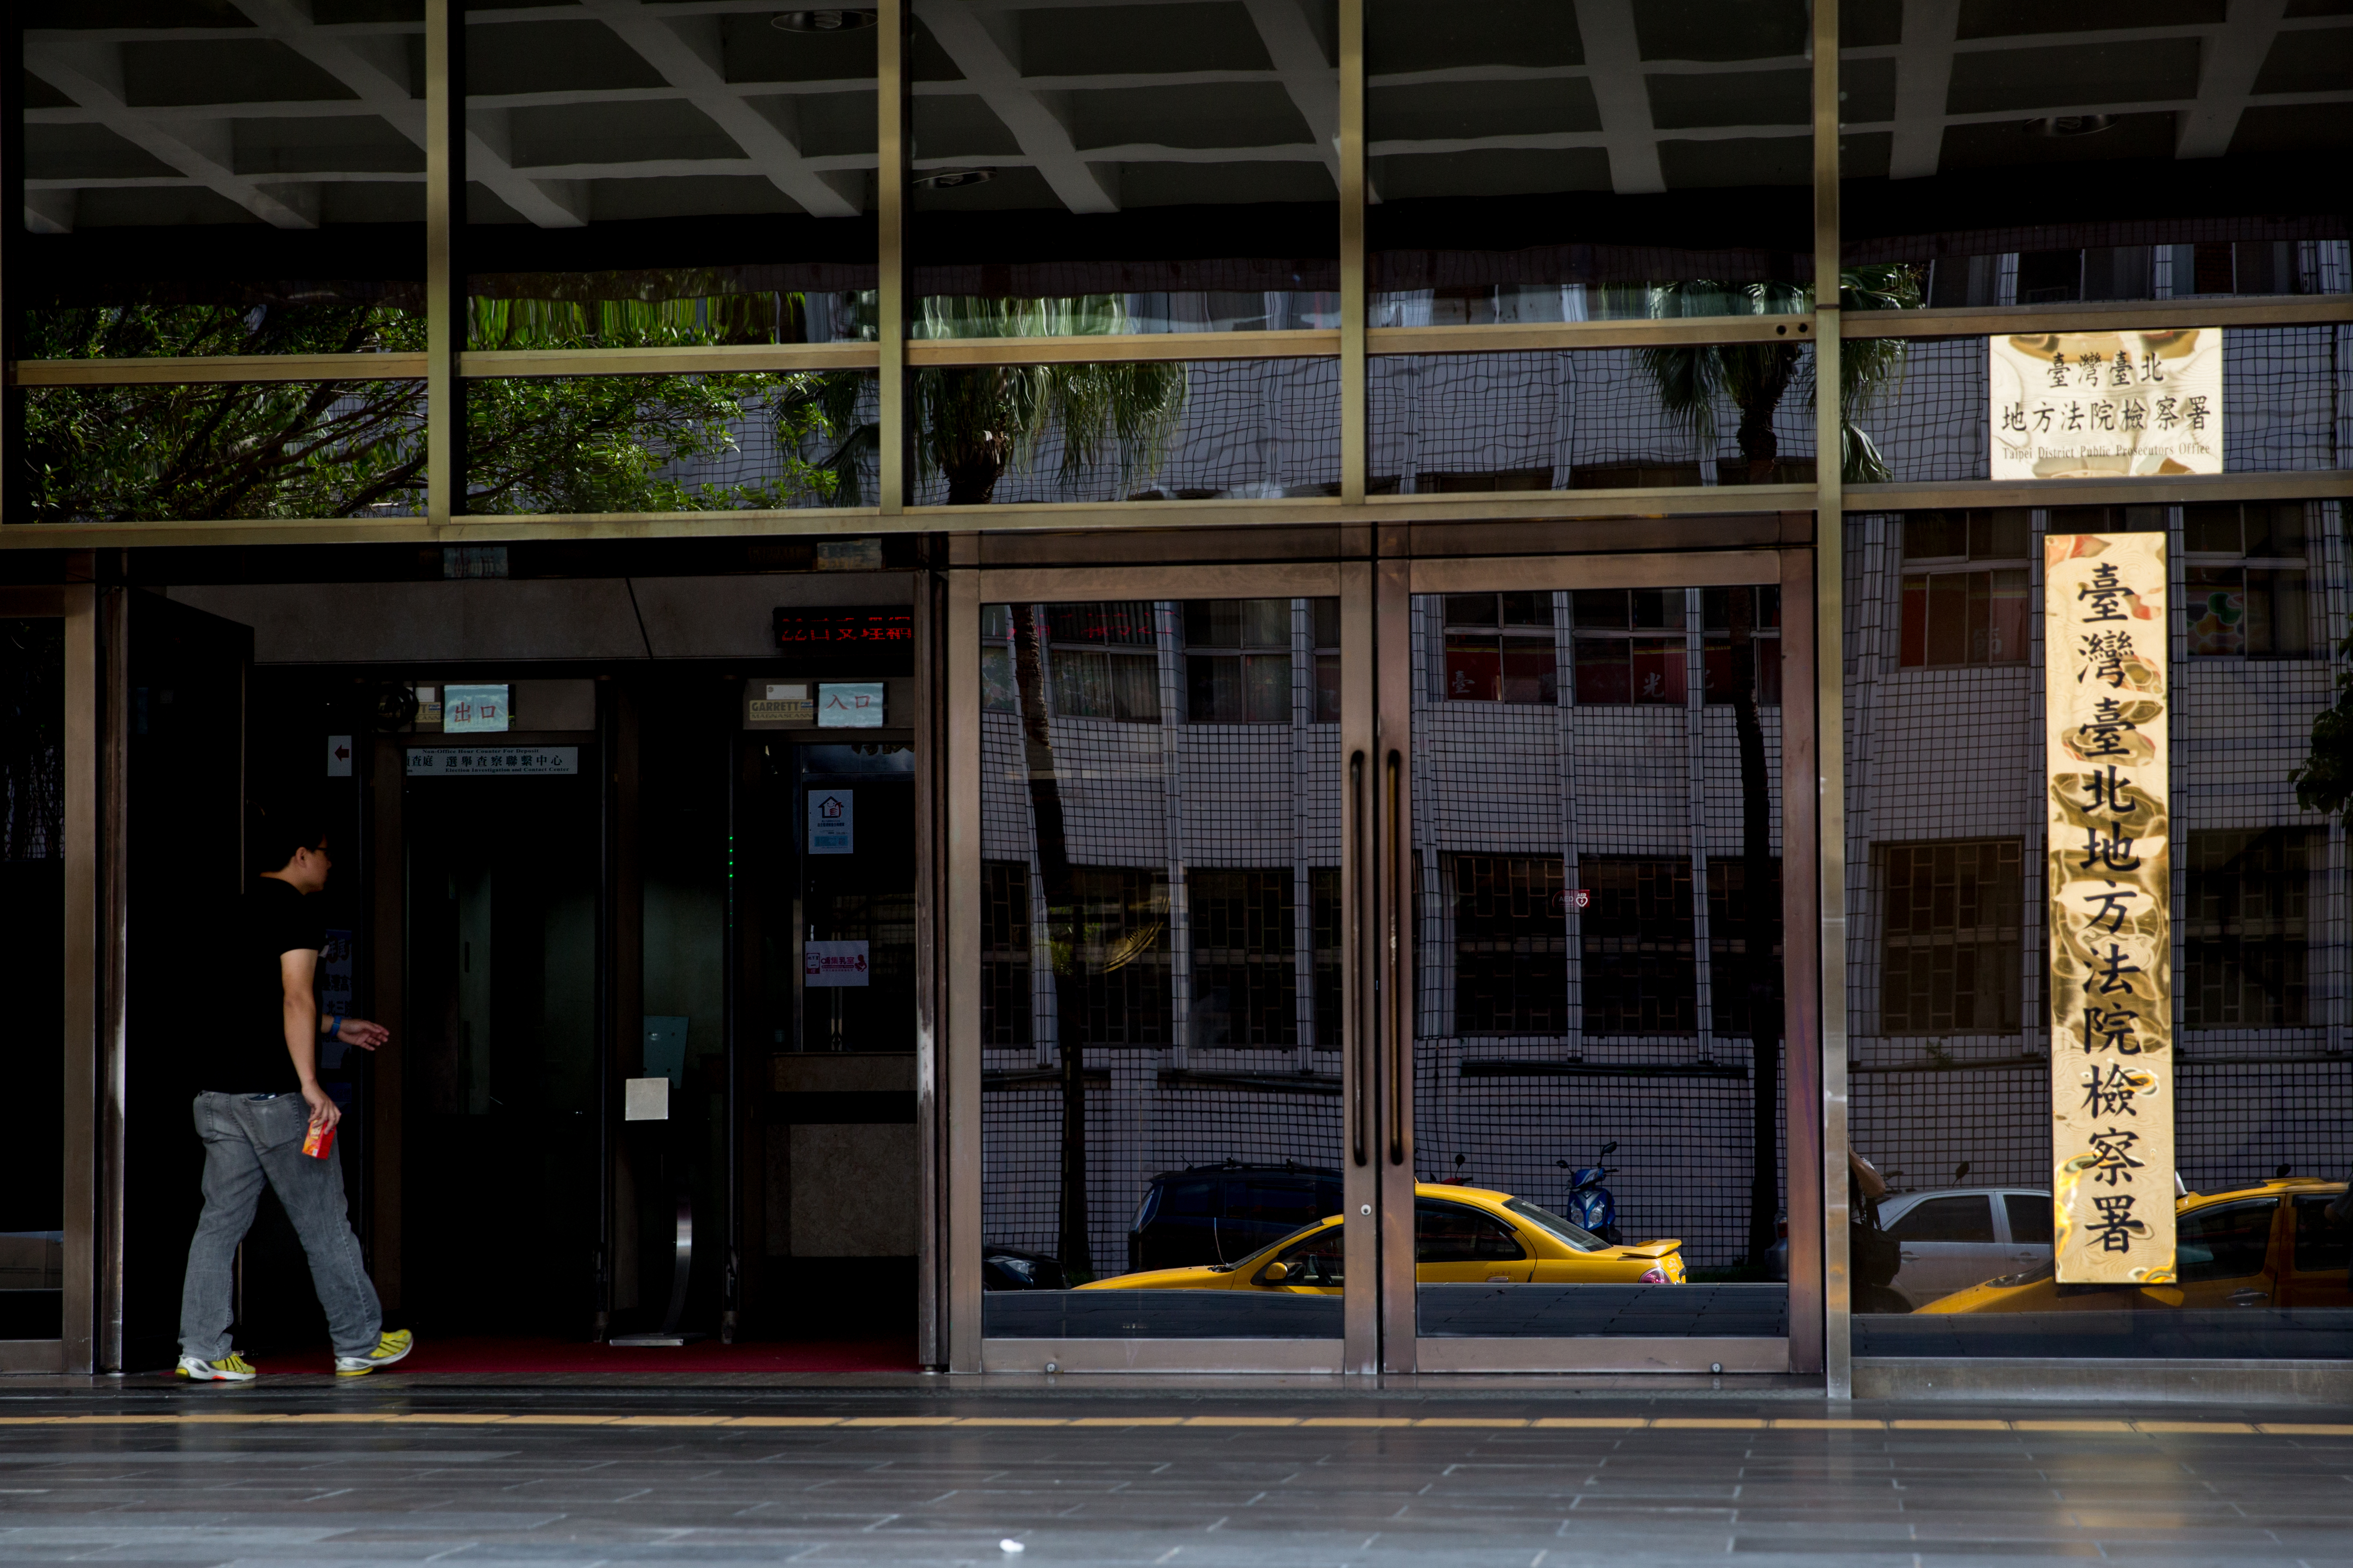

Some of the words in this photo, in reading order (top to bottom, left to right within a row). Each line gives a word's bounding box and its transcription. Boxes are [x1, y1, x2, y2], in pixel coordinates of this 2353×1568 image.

[2047, 350, 2164, 388] 臺灣臺北
[2001, 395, 2211, 433] 地方法院檢察署
[2002, 447, 2033, 462] Taipei
[2038, 444, 2074, 458] District
[2080, 444, 2110, 457] Public
[2116, 443, 2174, 456] Prosecutors
[2179, 442, 2210, 455] Office
[752, 701, 800, 712] GARRETT
[826, 694, 870, 710] 入口
[454, 702, 496, 723] 出口
[445, 755, 563, 767] 選舉查察聯繫中心
[2077, 562, 2145, 1254] 臺灣臺北地方法院檢察署
[820, 957, 854, 965] 哺集乳室
